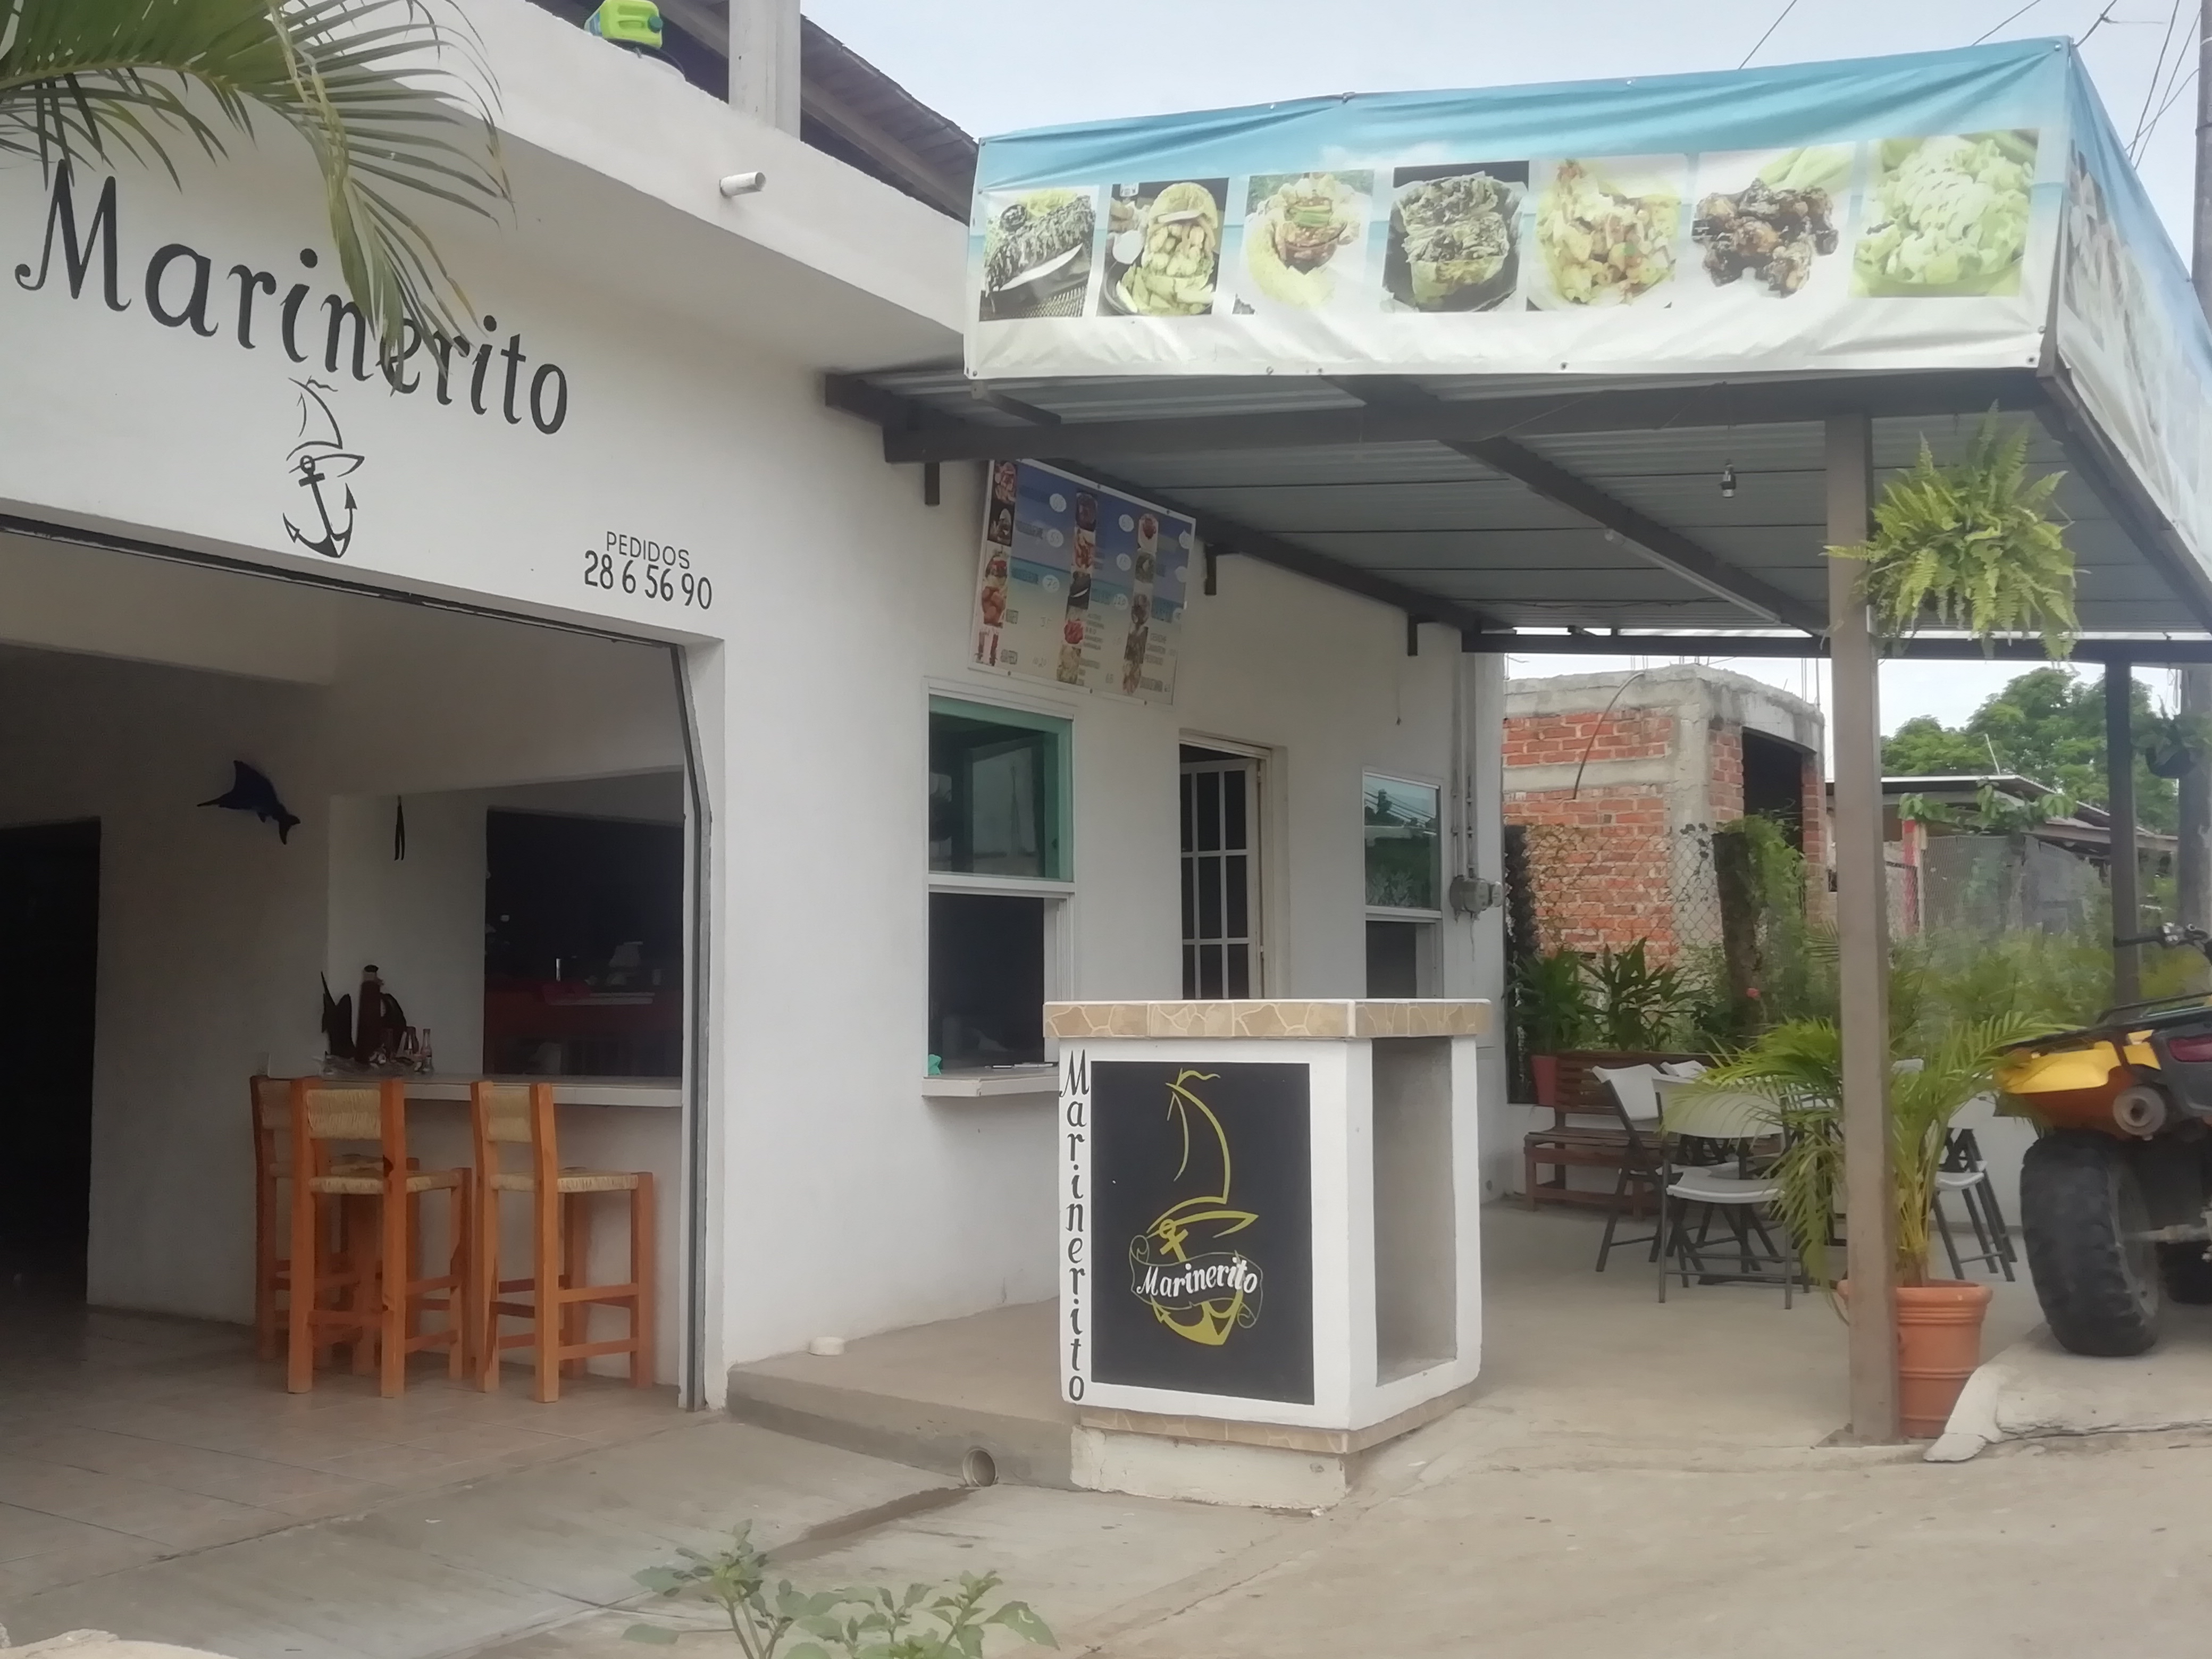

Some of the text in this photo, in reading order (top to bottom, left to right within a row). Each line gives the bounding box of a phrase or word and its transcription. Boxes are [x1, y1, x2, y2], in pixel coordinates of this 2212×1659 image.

[14, 158, 567, 434] Marinerito
[584, 549, 614, 590] 28
[606, 531, 690, 569] PEDIDOS
[1059, 1049, 1090, 1402] Marinerito
[1136, 1257, 1258, 1297] Marinerito
